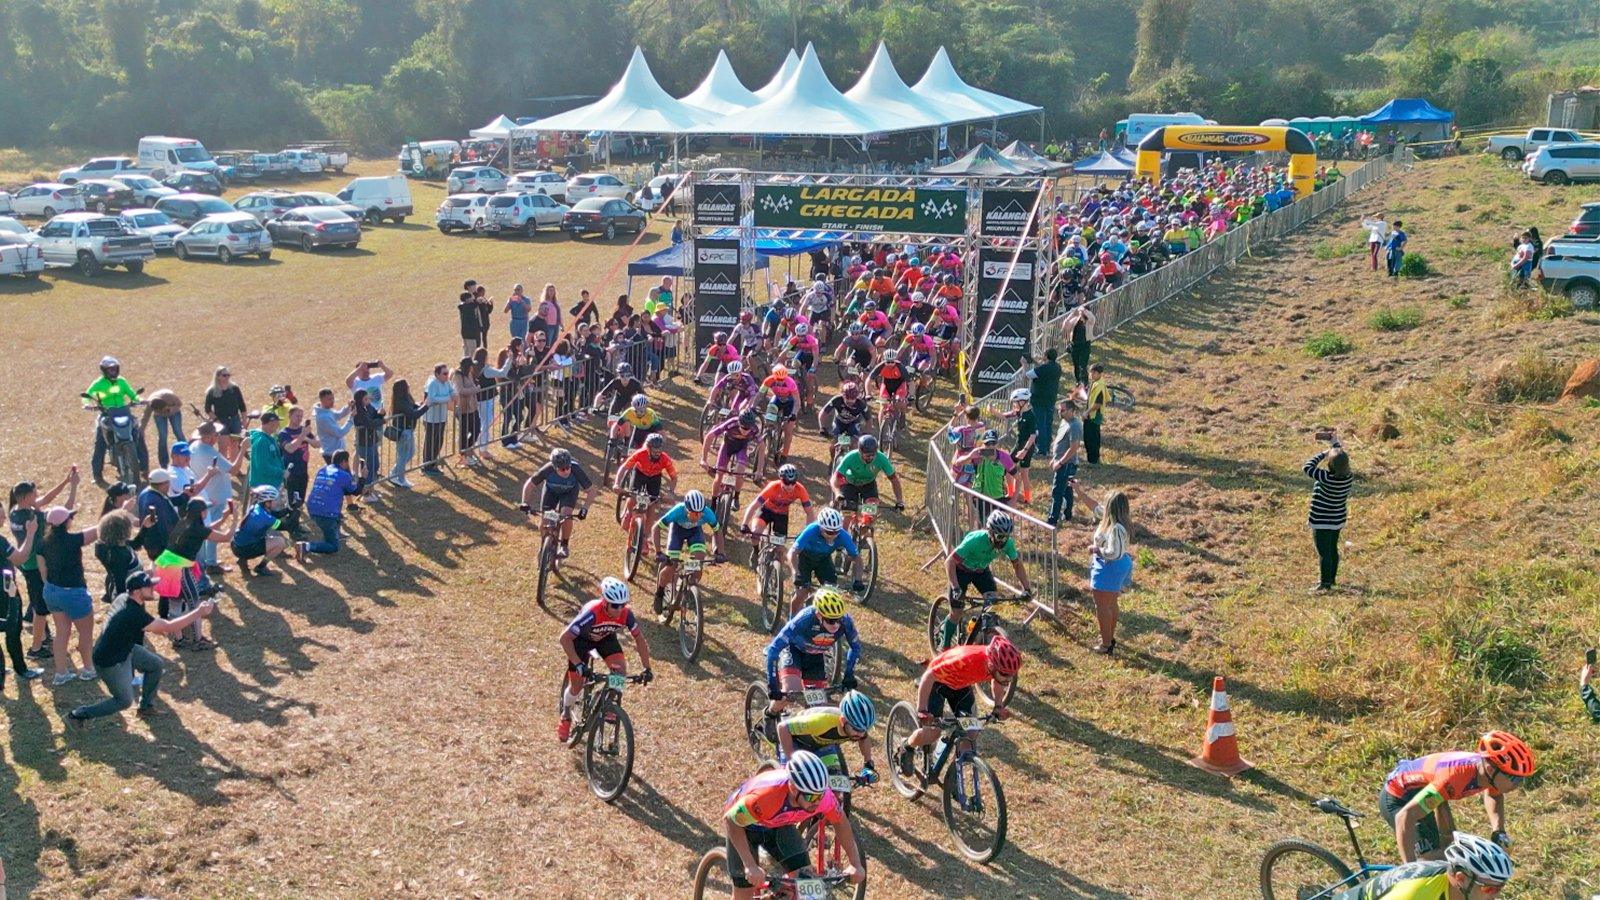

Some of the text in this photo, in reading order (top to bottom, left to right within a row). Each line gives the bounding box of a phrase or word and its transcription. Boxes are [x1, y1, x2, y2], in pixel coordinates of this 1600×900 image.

[800, 187, 916, 203] LARGADA
[697, 203, 735, 212] KALANGAS
[800, 203, 914, 220] CHEGADA
[854, 223, 884, 231] FINISH
[699, 282, 737, 291] KALANGAS
[982, 299, 1028, 309] KAANGAS
[700, 315, 737, 324] KALANGAS
[981, 334, 1026, 345] ALANGAS
[978, 370, 1013, 380] KALANG
[806, 691, 824, 702] 893
[830, 777, 849, 789] 825
[799, 884, 822, 896] 806
